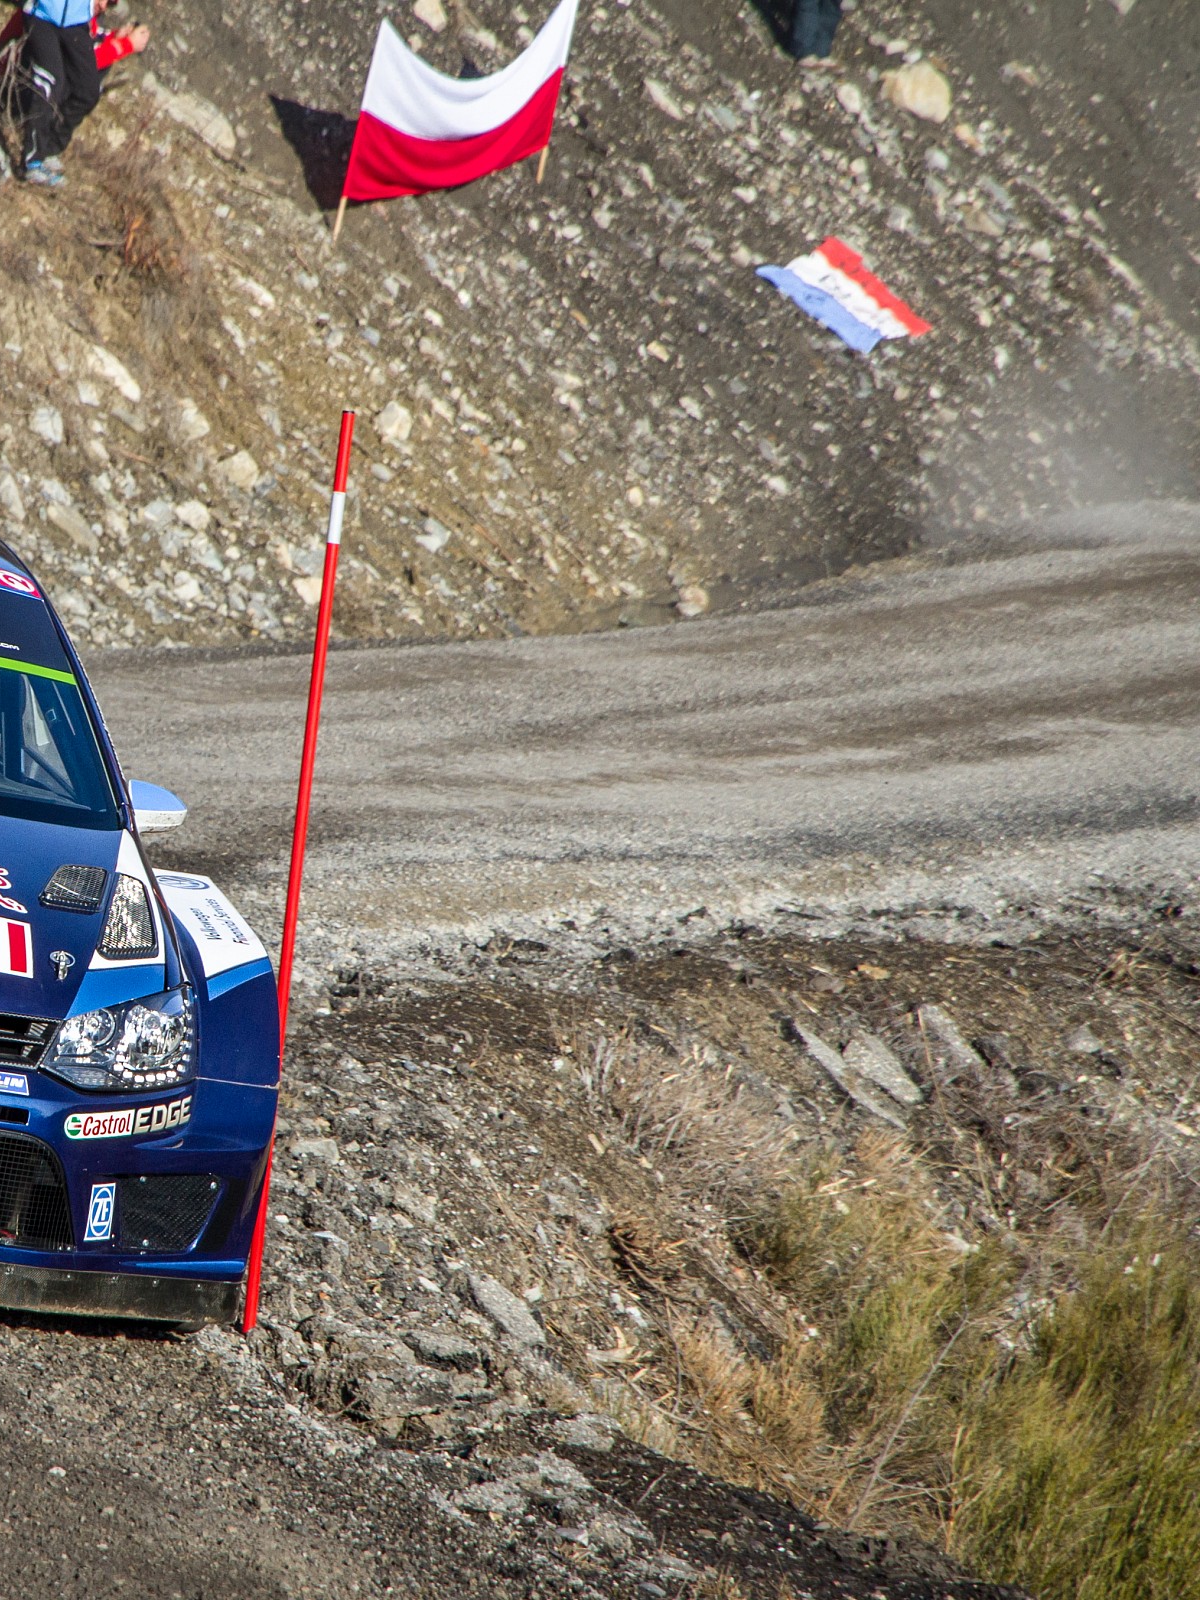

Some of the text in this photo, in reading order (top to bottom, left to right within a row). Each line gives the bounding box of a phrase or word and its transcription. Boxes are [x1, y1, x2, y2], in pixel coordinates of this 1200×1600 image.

[82, 1095, 193, 1137] Castrol EDGE
[91, 1194, 112, 1229] ZF
